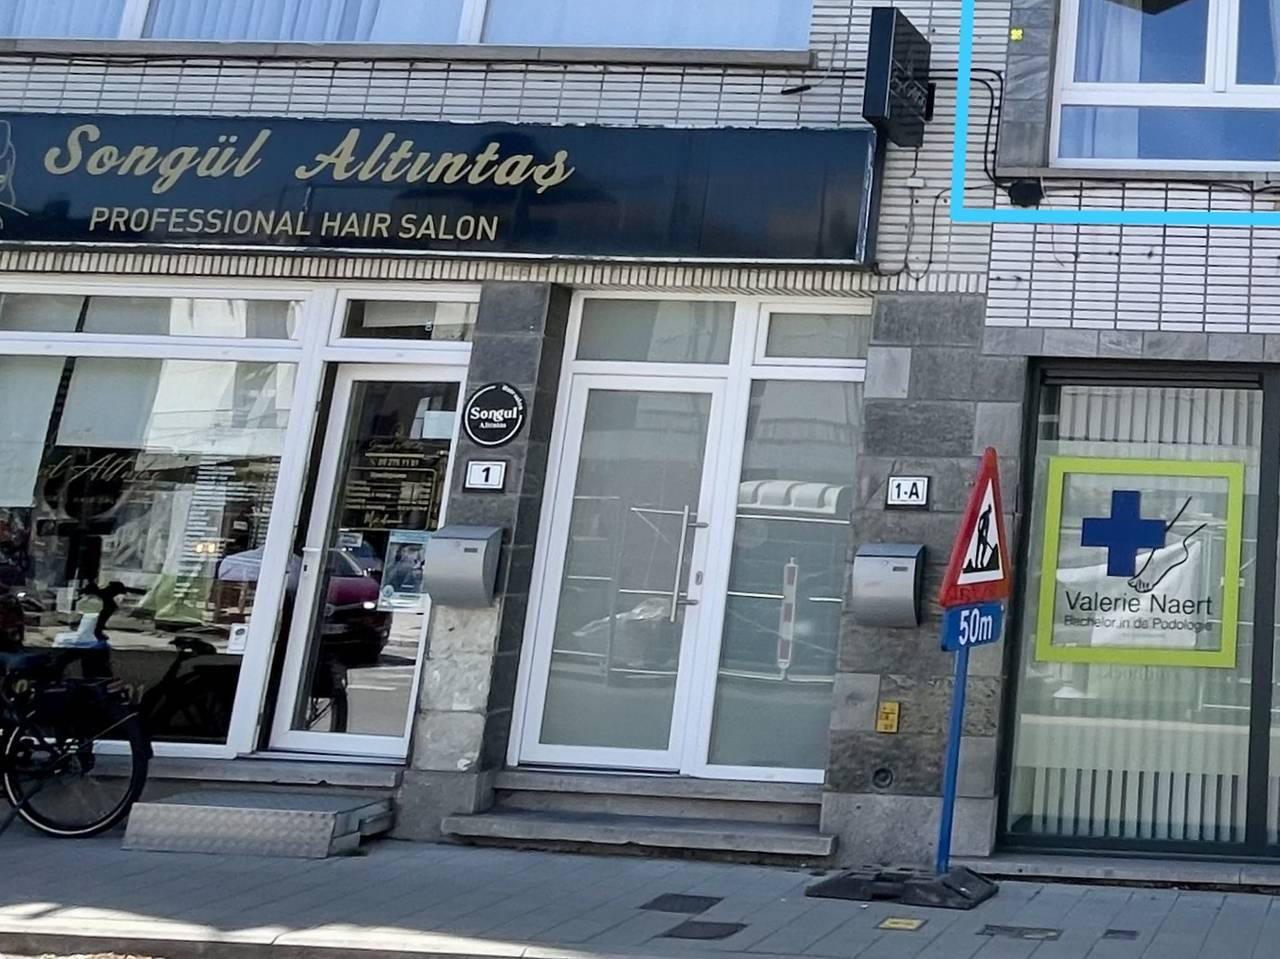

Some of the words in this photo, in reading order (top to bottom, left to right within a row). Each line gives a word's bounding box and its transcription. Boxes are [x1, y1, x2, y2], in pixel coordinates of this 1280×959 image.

[44, 124, 271, 194] Songül
[88, 206, 311, 236] PROFESSIONAL
[320, 211, 391, 238] HAIR
[399, 213, 498, 240] SALON
[481, 465, 492, 483] 1
[1065, 590, 1141, 614] Valerie
[1150, 594, 1214, 615] Naert
[958, 608, 993, 646] 50m
[1152, 617, 1213, 633] Podologie
